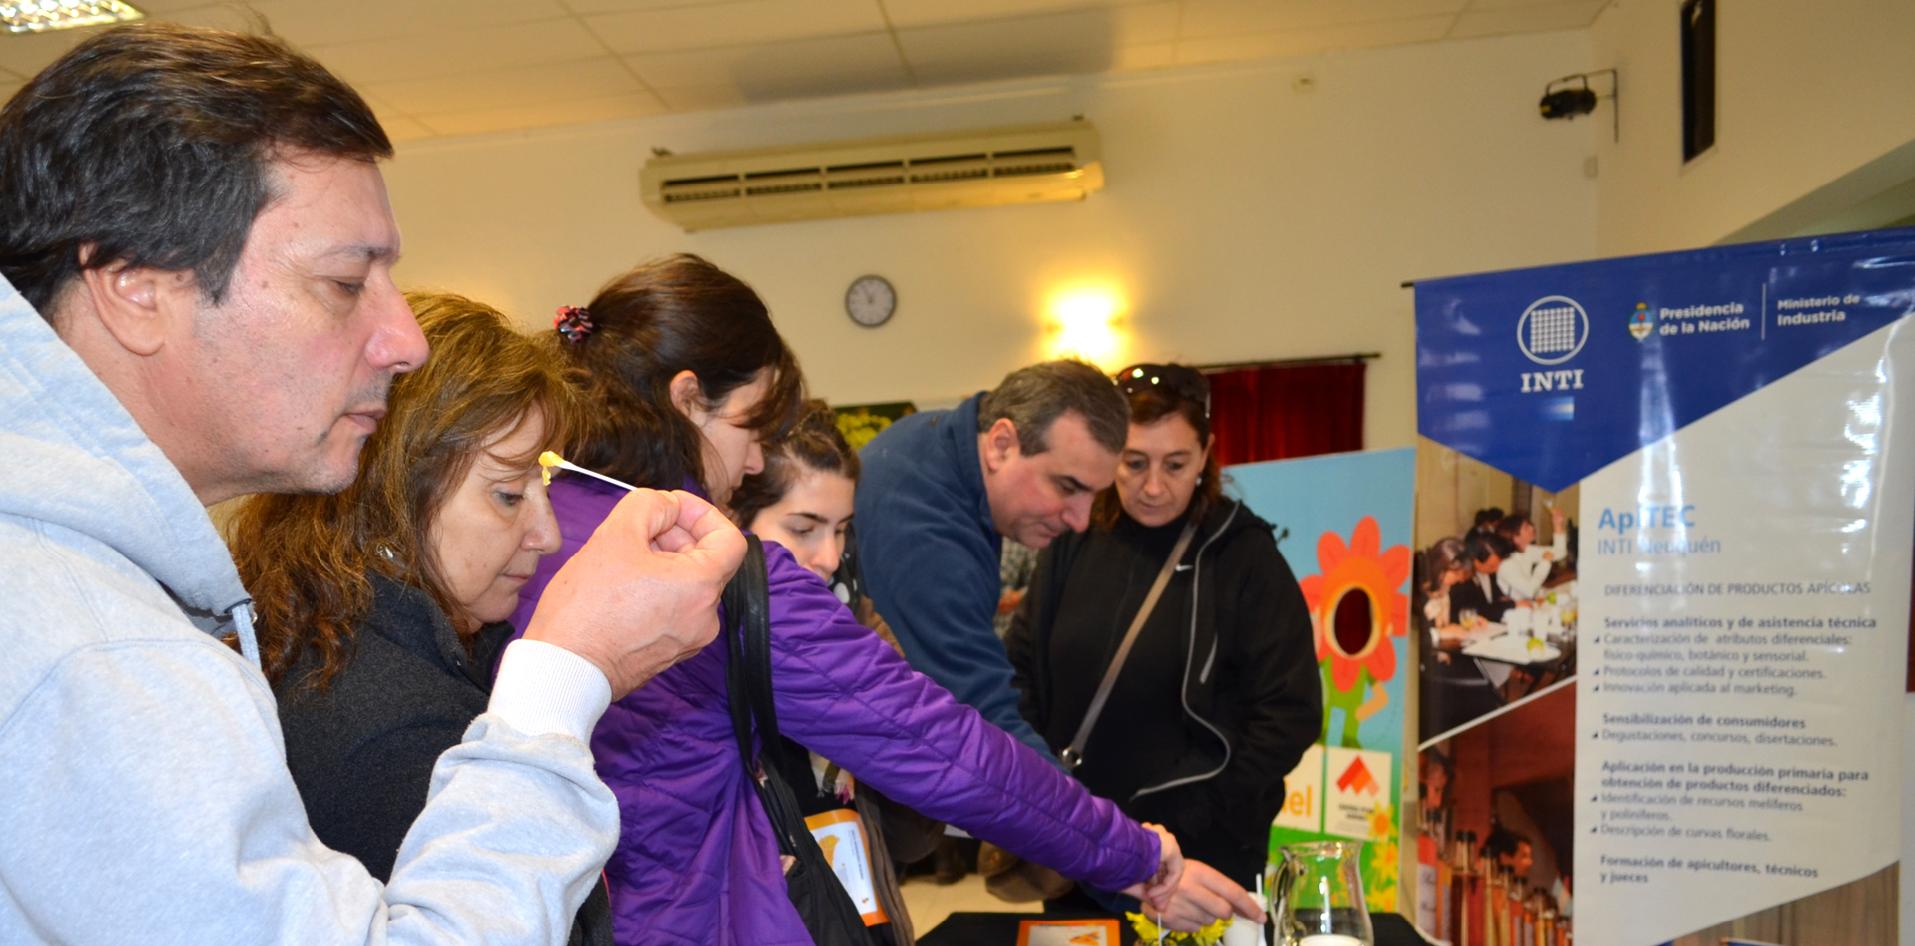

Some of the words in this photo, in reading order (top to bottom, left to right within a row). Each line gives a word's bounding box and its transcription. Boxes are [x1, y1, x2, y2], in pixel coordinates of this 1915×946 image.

[1777, 295, 1840, 311] Ministerio
[1843, 294, 1861, 306] de
[1660, 302, 1744, 320] Presidencia
[1777, 309, 1846, 327] Industria
[1660, 321, 1678, 336] de
[1682, 320, 1695, 334] la
[1698, 316, 1750, 334] Nación
[1521, 369, 1584, 393] INTI
[1597, 539, 1632, 555] INTI
[1708, 582, 1723, 596] DE
[1727, 581, 1802, 595] PRODUCTOS
[1807, 580, 1871, 594] APÍCAS
[1604, 617, 1658, 628] Servicios
[1662, 617, 1722, 628] analíticos
[1738, 617, 1753, 628] de
[1758, 617, 1823, 628] asistencia
[1828, 617, 1877, 629] técnica
[1603, 633, 1690, 644] Caracterización
[1694, 633, 1708, 644] de
[1716, 633, 1767, 645] atributos
[1688, 650, 1740, 661] botánico
[1603, 666, 1662, 677] Protocolos
[1665, 667, 1679, 677] de
[1683, 667, 1725, 678] calidad
[1603, 683, 1665, 693] Innovación
[1667, 683, 1716, 696] aplicada
[1719, 683, 1730, 694] al
[1603, 713, 1693, 726] Sensibilización
[1697, 715, 1713, 726] de
[1716, 716, 1806, 728] consumidores
[1602, 760, 1666, 774] Aplicación
[1669, 764, 1684, 773] en
[1687, 762, 1699, 773] la
[1703, 763, 1774, 777] producción
[1778, 767, 1834, 780] primaria
[1838, 770, 1869, 782] para
[1601, 777, 1663, 788] obtención
[1666, 779, 1682, 789] de
[1685, 780, 1749, 792] productos
[1753, 782, 1847, 798] diferenciados:
[1282, 784, 1313, 817] el
[1680, 794, 1694, 805] de
[1697, 798, 1744, 808] recursos
[1600, 824, 1665, 838] Descripción
[1668, 826, 1682, 837] de
[1686, 829, 1723, 840] curvas
[1600, 855, 1664, 868] Formación
[1667, 857, 1683, 868] de
[1687, 859, 1760, 876] apicultores,
[1765, 864, 1818, 878] técnicos
[1609, 871, 1648, 884] jueces
